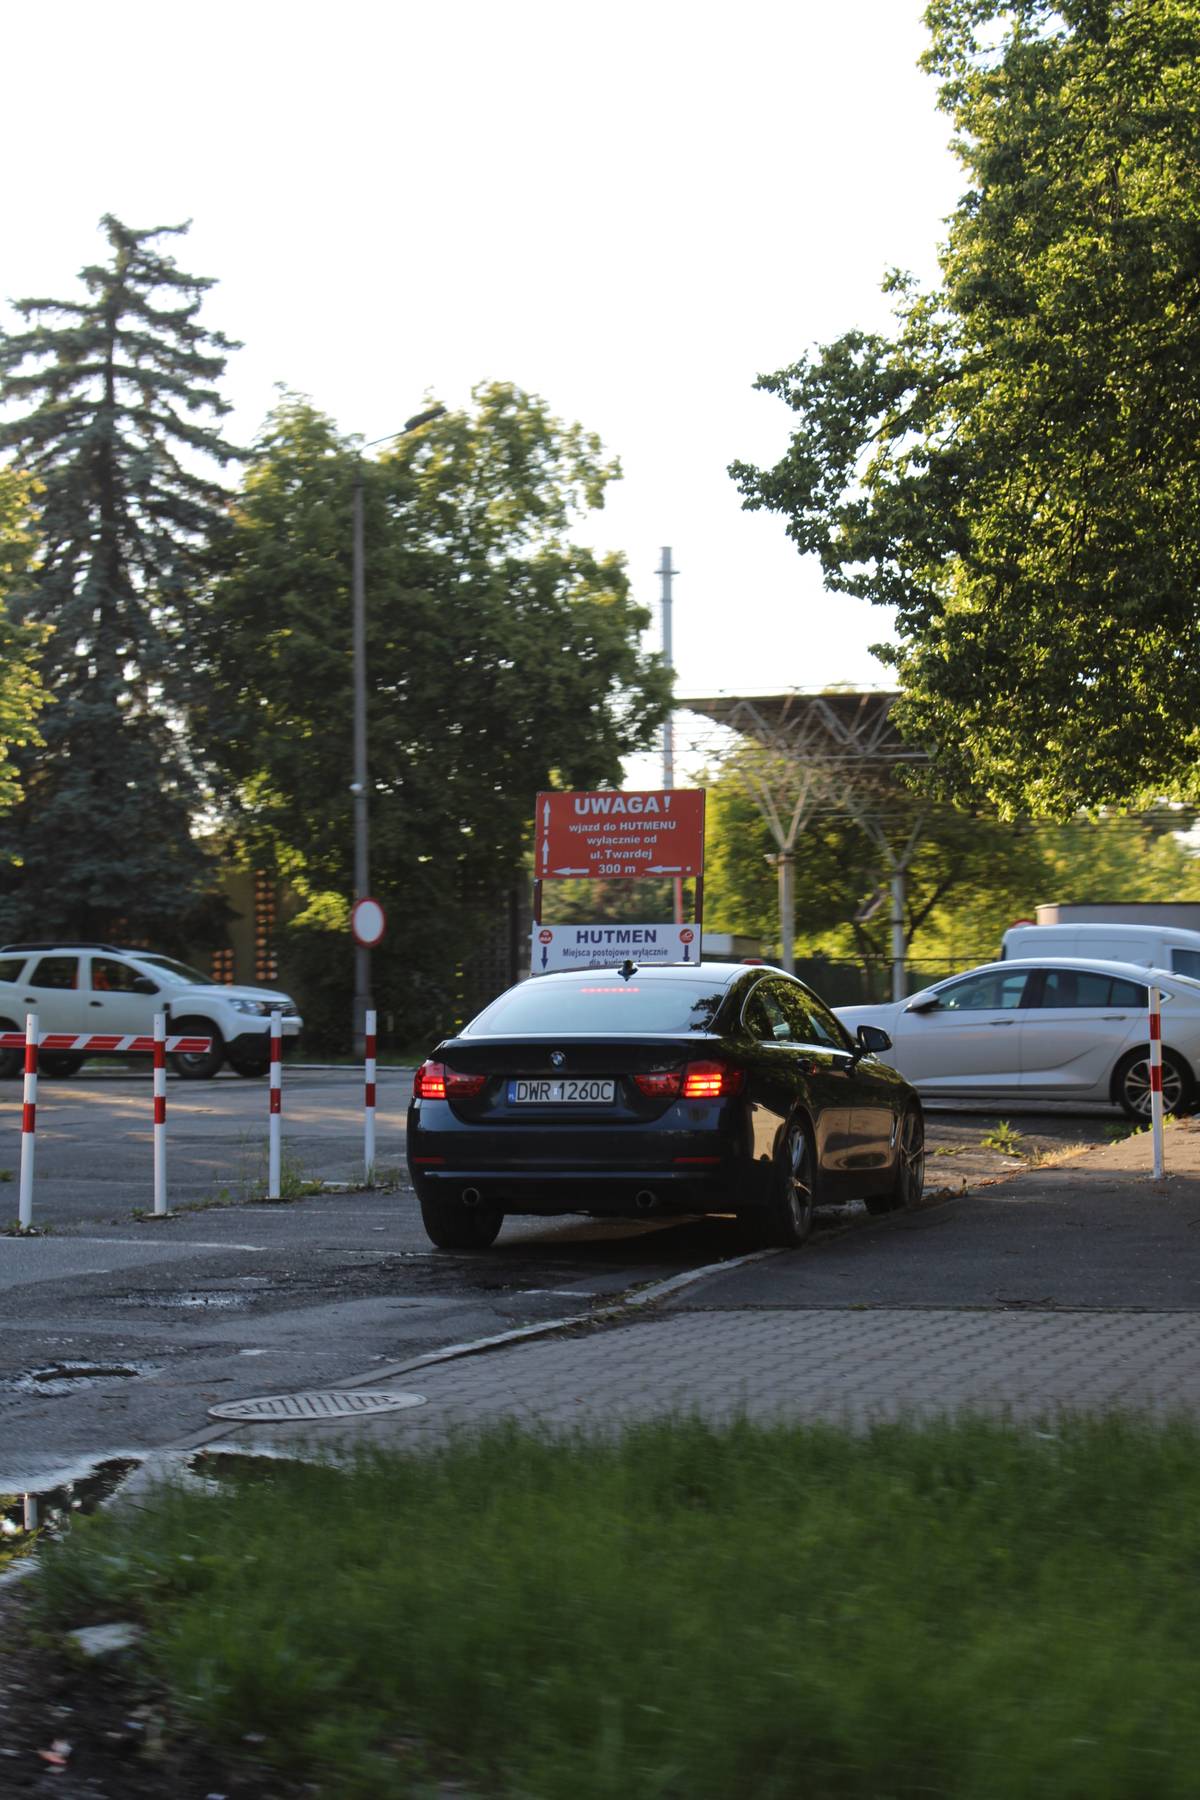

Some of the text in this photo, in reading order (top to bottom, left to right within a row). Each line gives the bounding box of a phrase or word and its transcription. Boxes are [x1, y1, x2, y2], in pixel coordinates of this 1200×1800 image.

[569, 821, 676, 833] wjazd do HUTMENU
[643, 835, 657, 844] od
[590, 849, 653, 861] ul. Twardej
[599, 864, 636, 874] 300 m
[576, 929, 657, 944] HUTMEN
[562, 946, 669, 959] Miejsca postojowe wyłącznie
[517, 1081, 613, 1101] DWR 1260C
